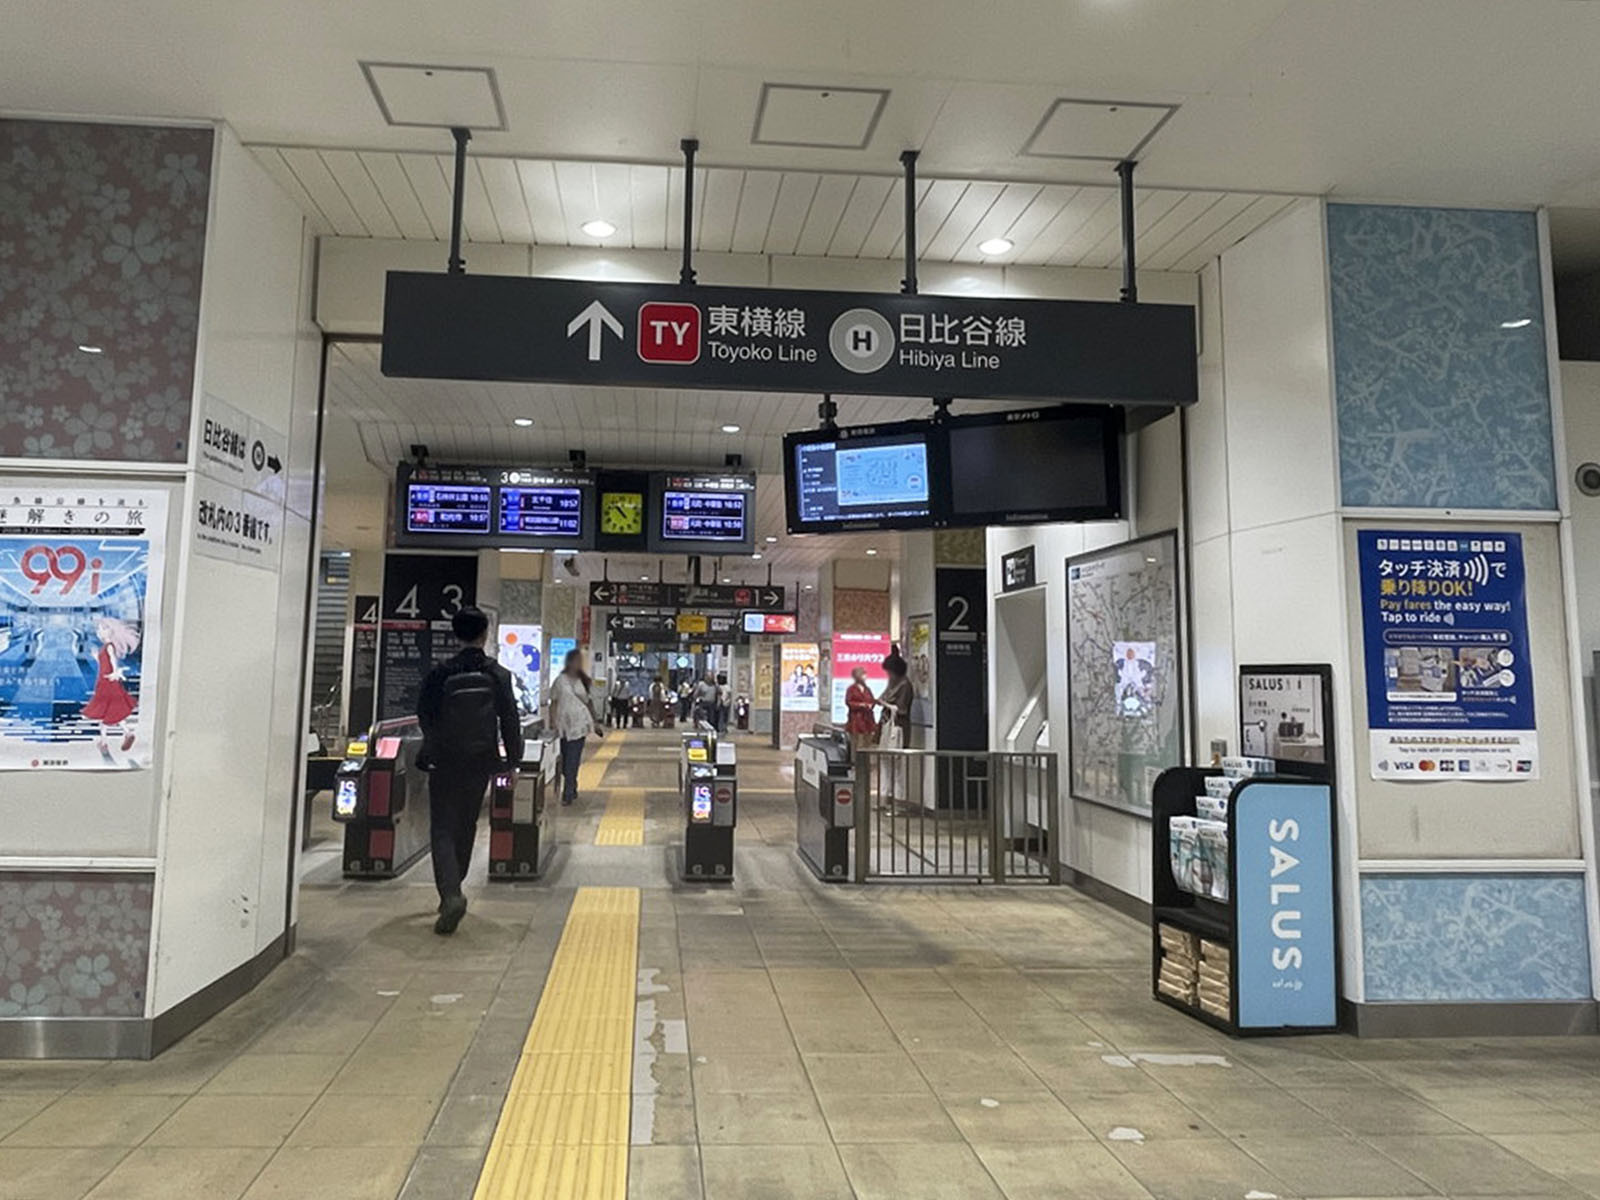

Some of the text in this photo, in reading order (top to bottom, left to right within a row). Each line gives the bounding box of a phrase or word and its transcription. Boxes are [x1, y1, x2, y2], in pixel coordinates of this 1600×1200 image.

[650, 320, 692, 346] TY
[708, 306, 807, 339] 東横線
[900, 313, 1027, 347] 日比谷線
[852, 331, 872, 351] H
[708, 341, 817, 363] Toyoko Line
[900, 349, 1000, 370] Hibiya Line
[203, 418, 246, 459] 日比谷線は
[1378, 559, 1507, 578] タッチ決済 で
[1380, 578, 1473, 597] 乗り降りOK!
[395, 584, 464, 619] 4 3
[1380, 599, 1511, 613] Pay fares the easy way!
[361, 603, 377, 623] 4
[947, 596, 969, 630] 2
[1381, 611, 1441, 624] Tap to ride
[1249, 678, 1284, 691] SALUS
[1394, 761, 1414, 770] VISA
[1269, 818, 1303, 971] SALUS
